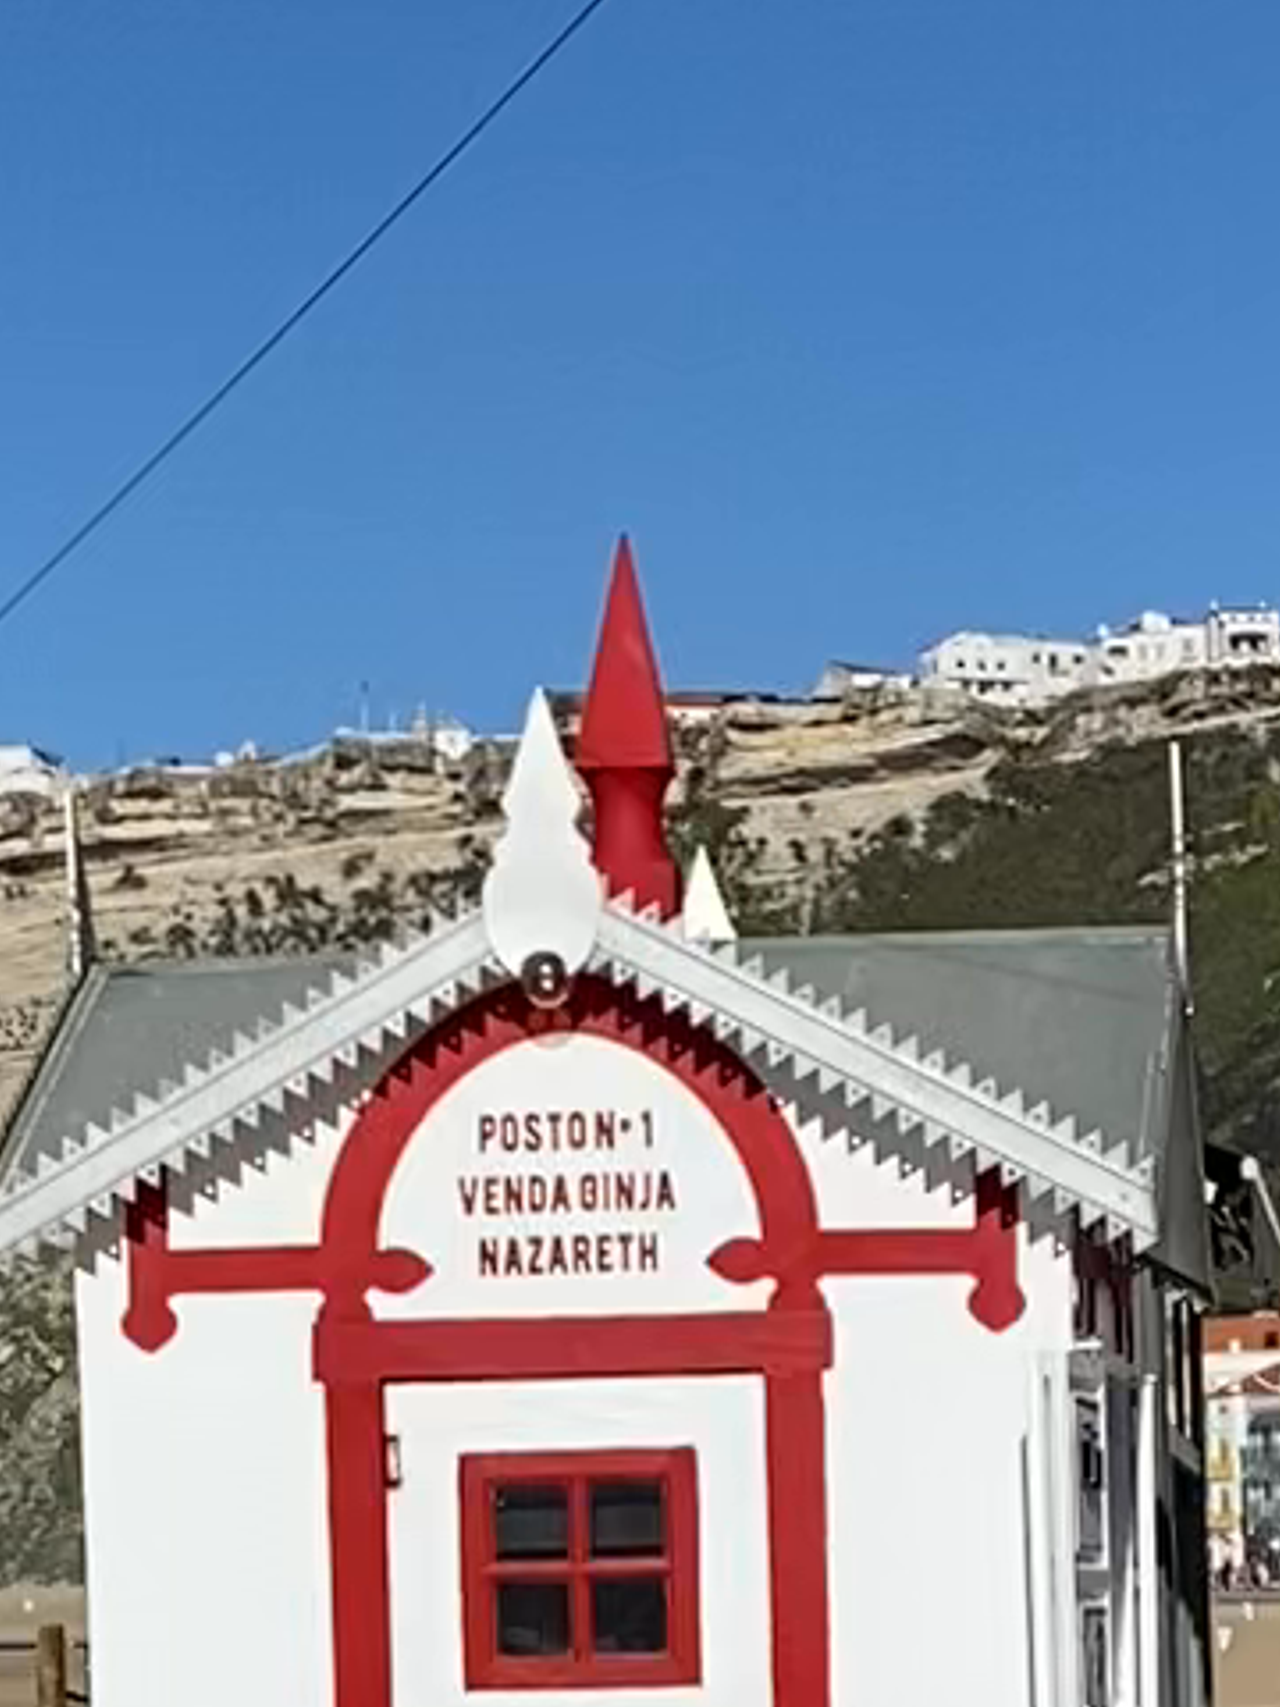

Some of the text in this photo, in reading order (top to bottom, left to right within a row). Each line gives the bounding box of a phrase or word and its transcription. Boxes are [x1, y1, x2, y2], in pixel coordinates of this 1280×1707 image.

[479, 1111, 587, 1154] POSTO
[458, 1174, 571, 1216] VENDA
[478, 1232, 658, 1277] NAZARETH
